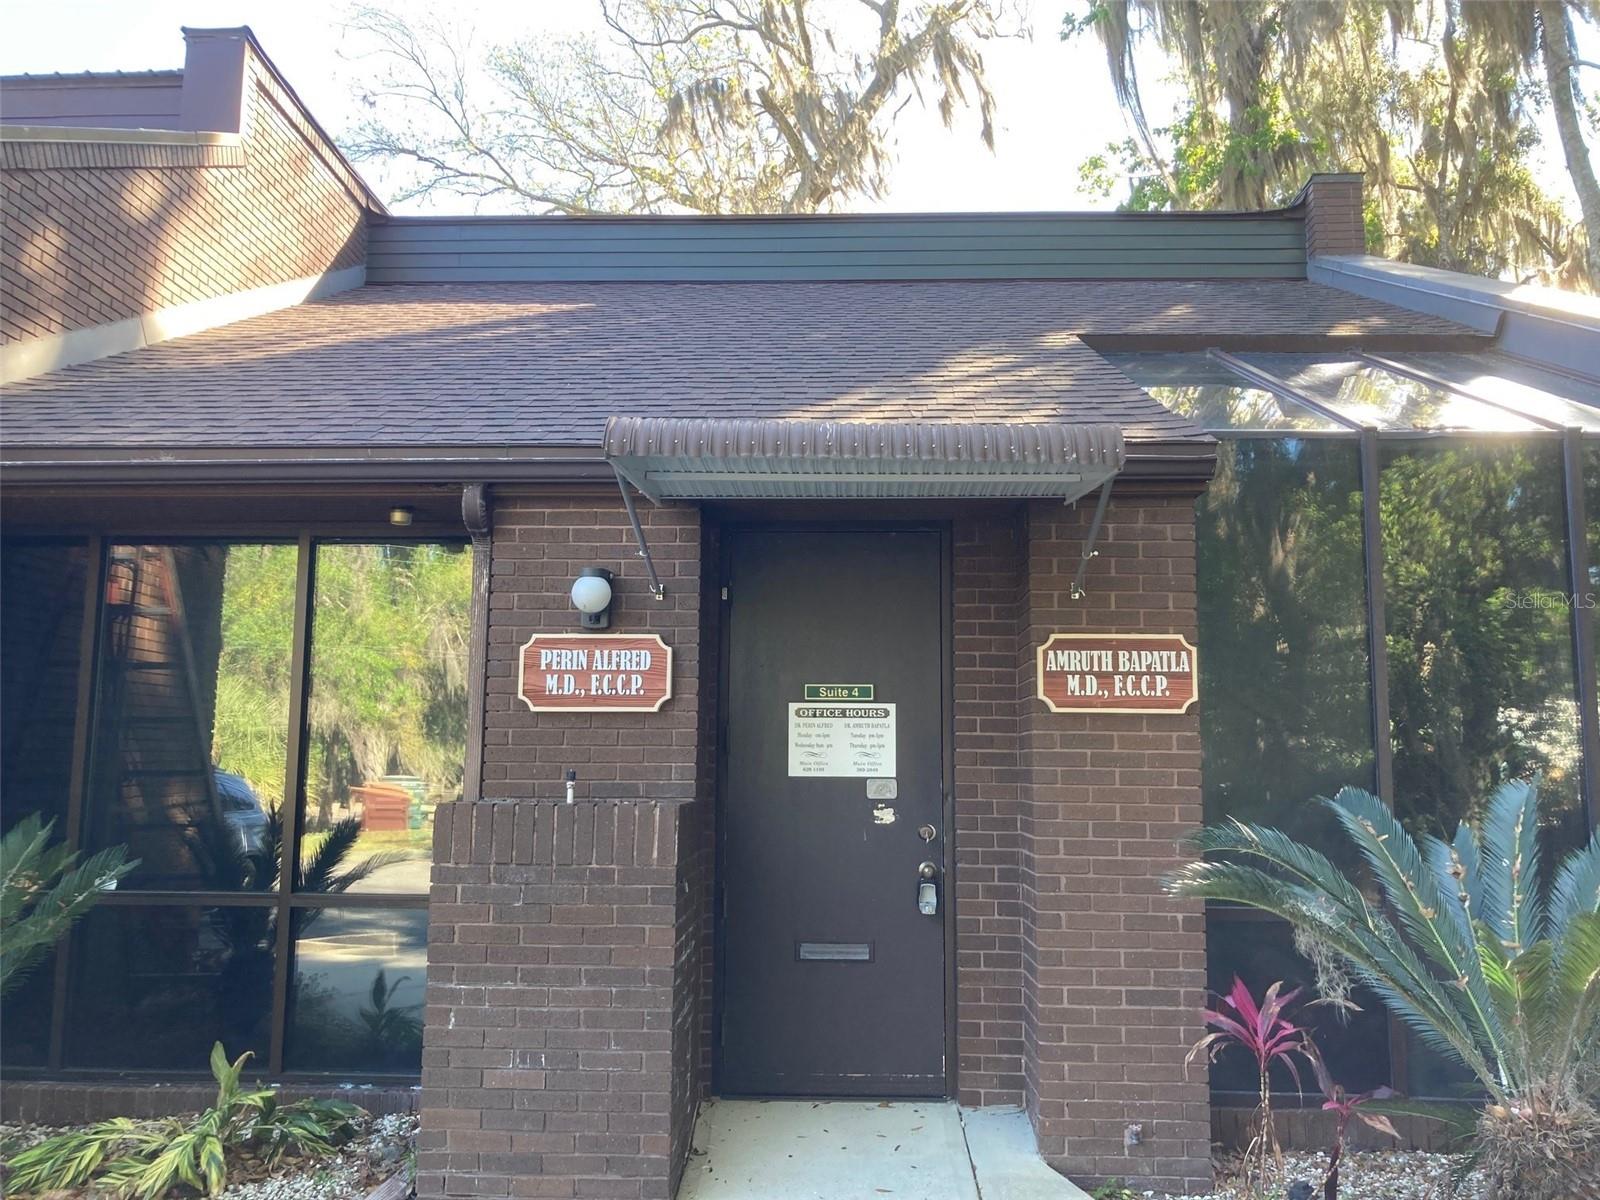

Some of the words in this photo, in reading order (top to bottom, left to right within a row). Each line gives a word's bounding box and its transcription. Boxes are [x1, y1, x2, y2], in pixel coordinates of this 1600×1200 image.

[540, 649, 588, 671] PERIN
[592, 649, 652, 671] ALFRED
[1046, 650, 1114, 672] AMRUTH
[1118, 650, 1190, 672] BAPATLA
[545, 674, 586, 698] M.D.,
[590, 674, 645, 696] F.C.C.P.
[819, 687, 849, 697] Suite
[851, 687, 859, 697] 4
[1066, 674, 1109, 699] M.D.,
[1113, 674, 1170, 697] F.C.C.P.
[799, 709, 843, 717] OFFICE
[846, 709, 885, 717] HOURS
